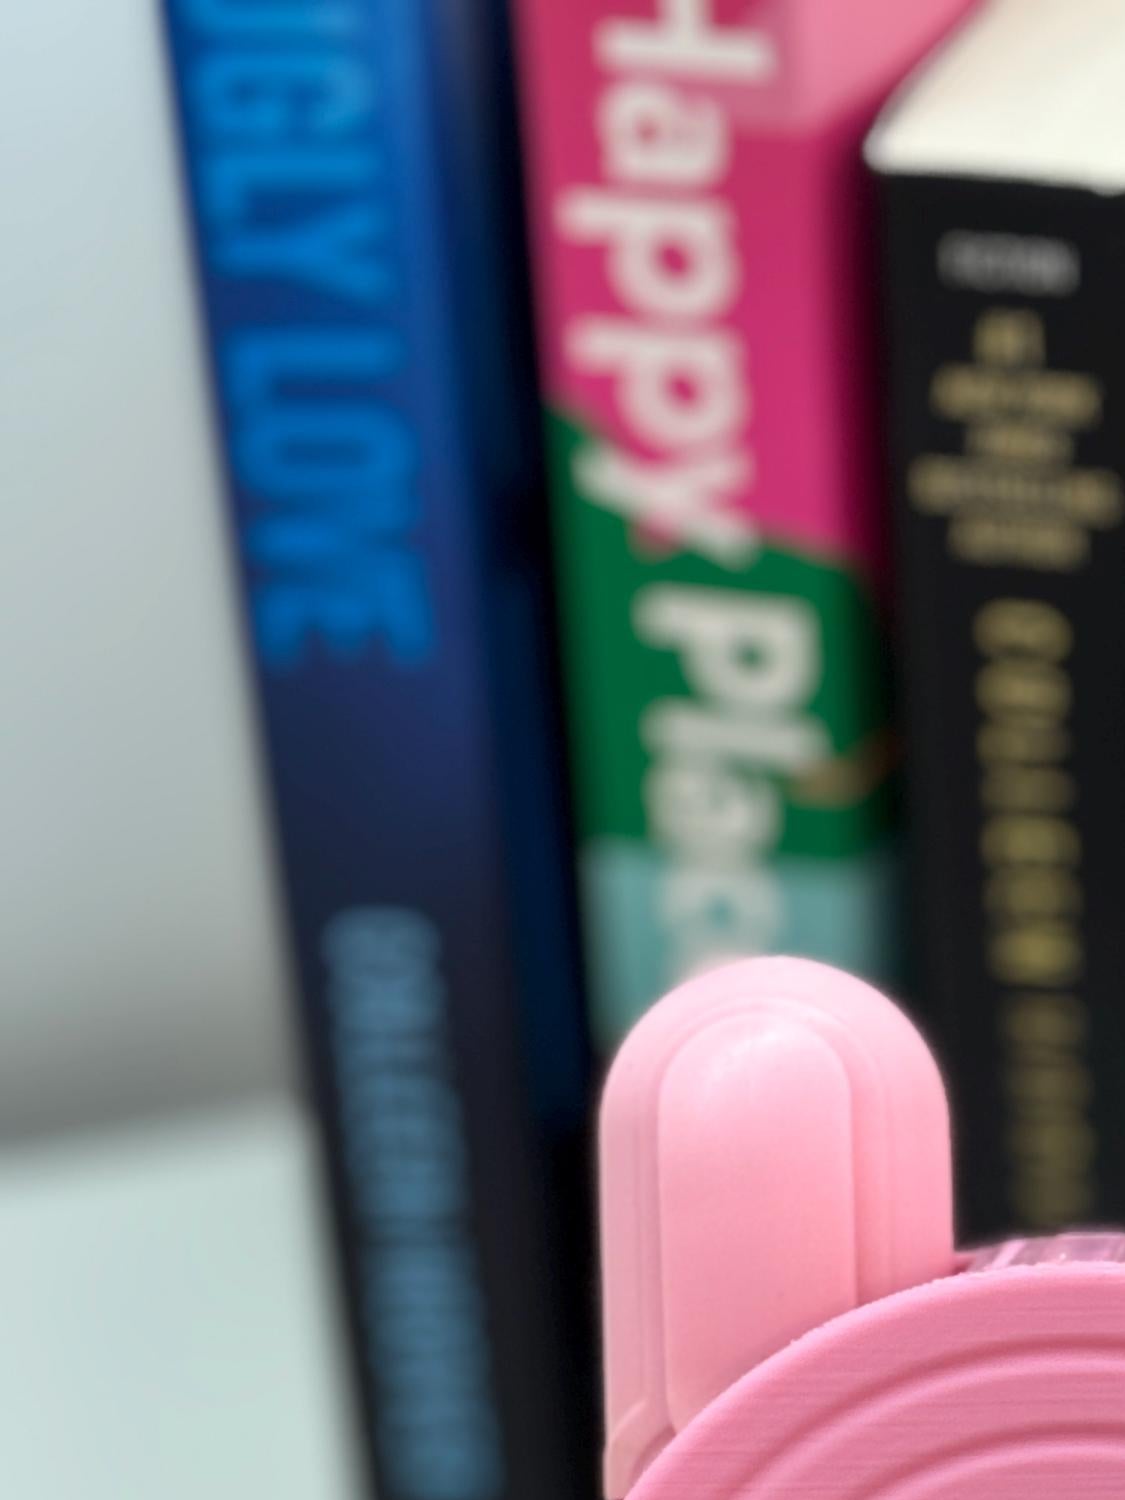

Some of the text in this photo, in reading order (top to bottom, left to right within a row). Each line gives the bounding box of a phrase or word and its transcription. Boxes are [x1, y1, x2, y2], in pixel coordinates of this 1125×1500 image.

[226, 328, 432, 664] LOVE
[556, 0, 832, 985] Happy Plac
